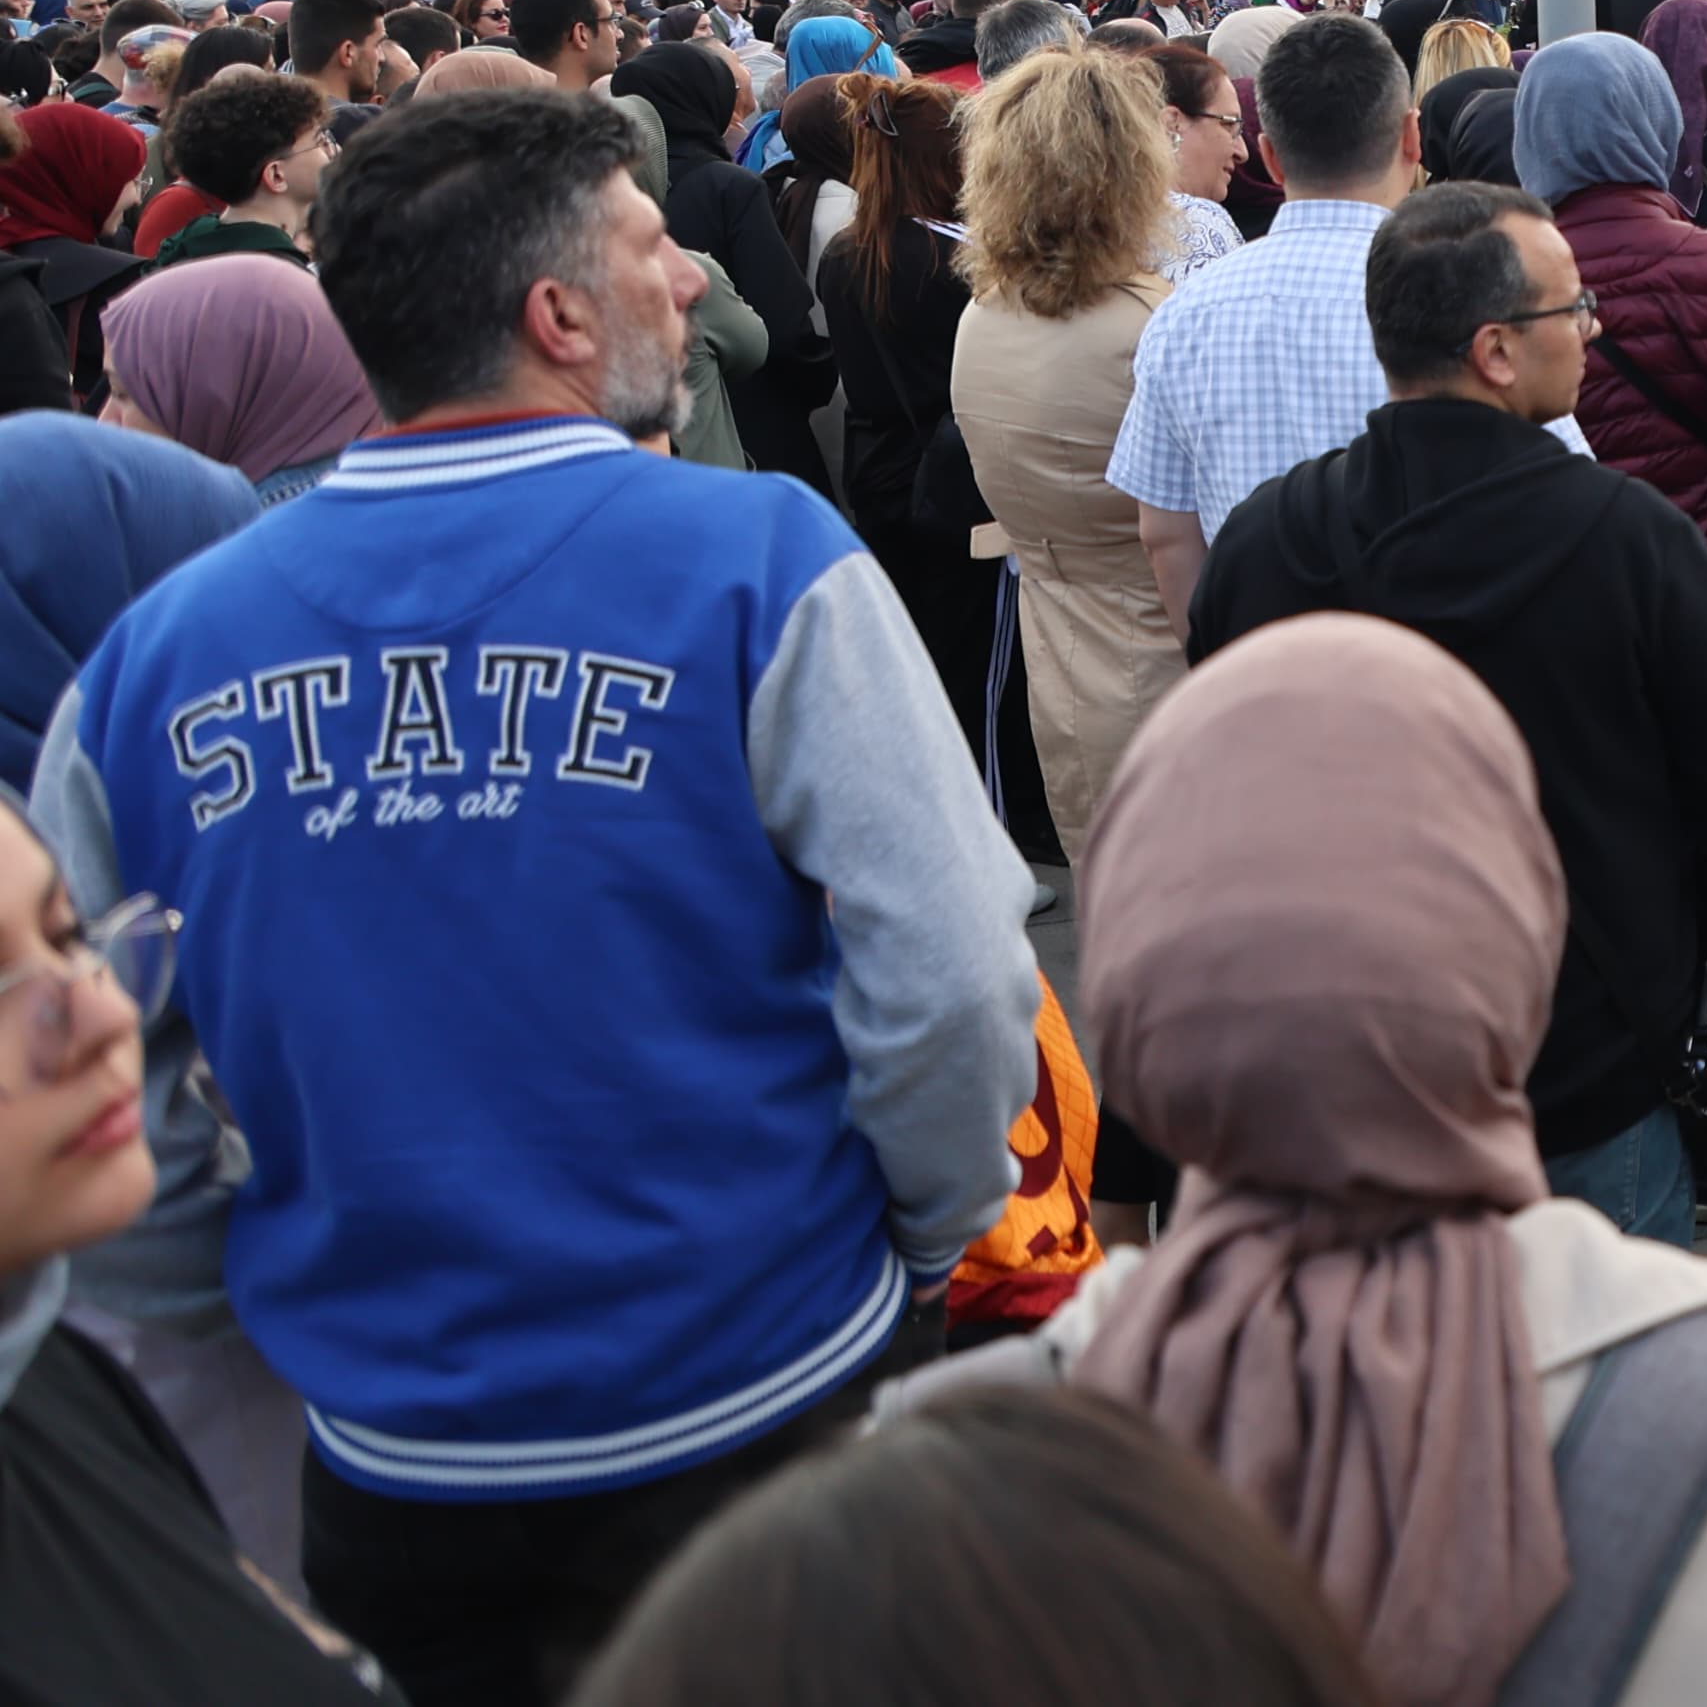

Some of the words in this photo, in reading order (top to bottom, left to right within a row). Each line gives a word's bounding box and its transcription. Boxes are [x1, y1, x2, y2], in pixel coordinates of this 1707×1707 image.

[168, 645, 675, 831] STATE
[305, 789, 358, 841] of
[374, 780, 443, 826] the
[457, 782, 523, 820] art
